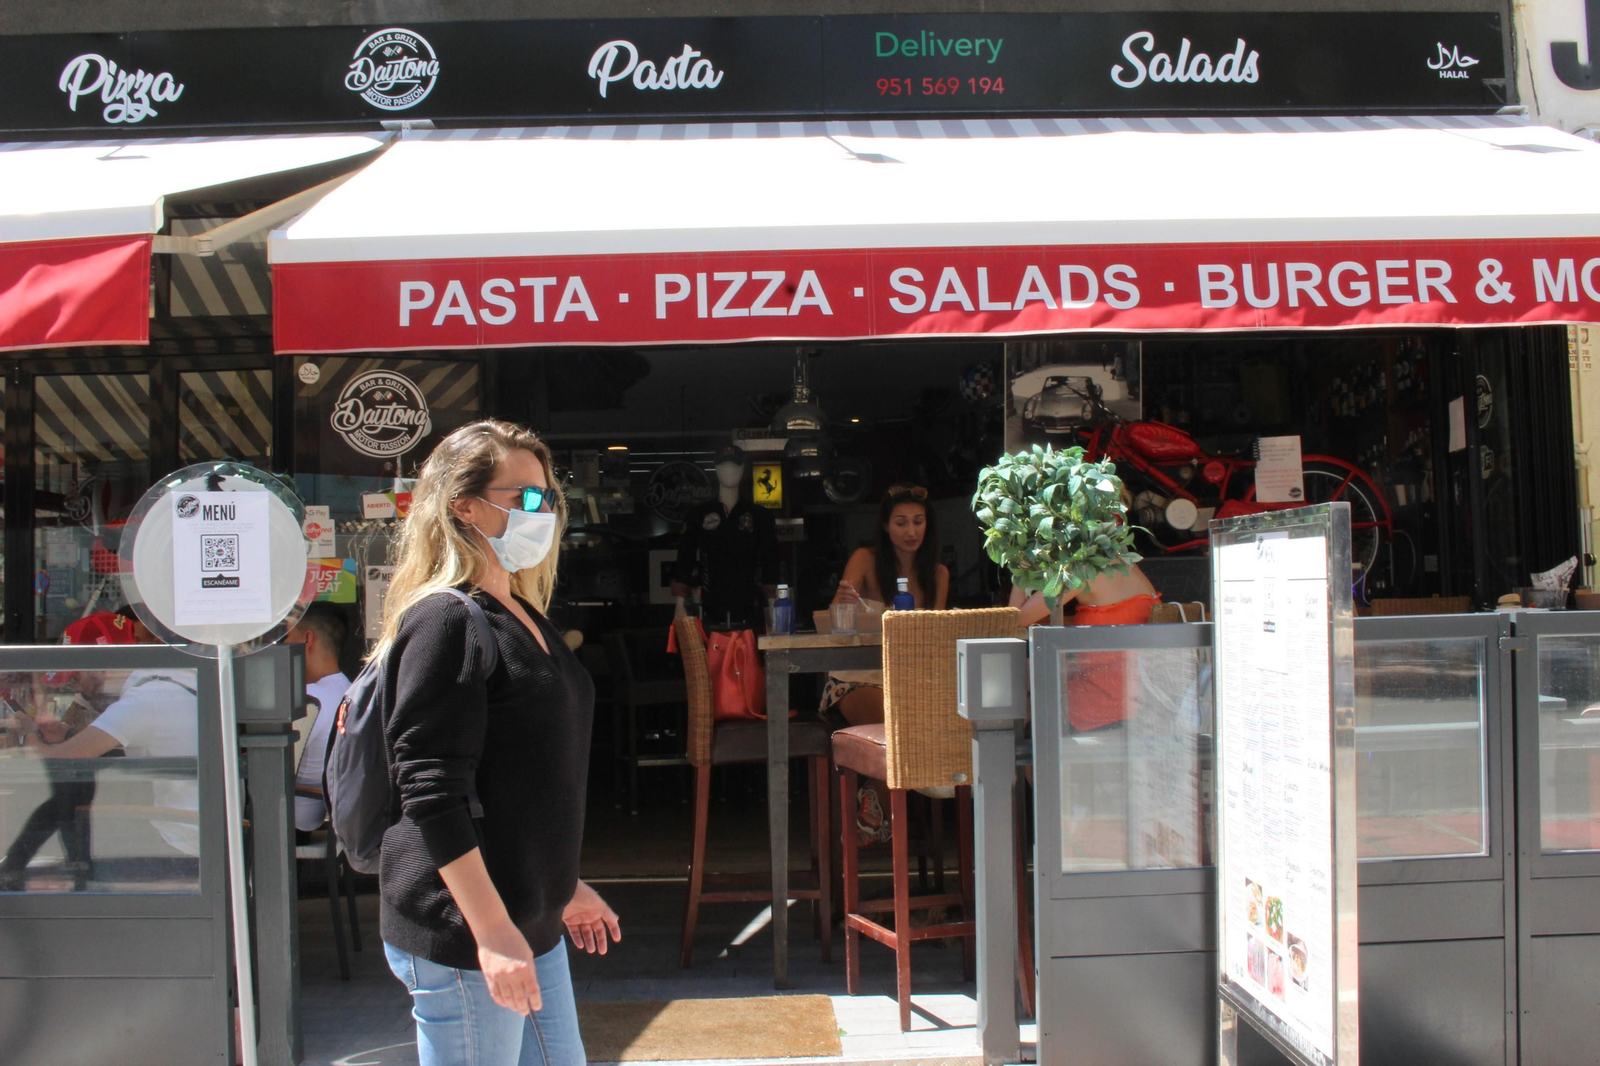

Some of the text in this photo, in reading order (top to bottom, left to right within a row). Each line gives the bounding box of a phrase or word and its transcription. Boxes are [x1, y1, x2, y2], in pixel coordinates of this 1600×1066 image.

[367, 36, 386, 49] BAR
[394, 33, 418, 48] GRILL
[875, 30, 1004, 64] Delivery
[1111, 31, 1260, 89] Salads
[1427, 41, 1480, 70] حلال
[344, 55, 440, 91] Daytona
[588, 39, 724, 98] Pasta
[1439, 70, 1470, 79] HALAL
[59, 53, 185, 124] Pizza
[365, 85, 425, 106] MOTOR PASSION
[875, 76, 1006, 97] 951 569 194
[399, 275, 600, 327] PASTA
[655, 269, 834, 320] PIZZA
[888, 263, 1141, 314] SALADS
[1197, 258, 1458, 309] BURGER
[1474, 258, 1516, 304] &
[359, 379, 377, 391] BAR
[385, 379, 408, 396] GRILL
[333, 398, 428, 434] Daytona
[353, 429, 412, 450] MOTOR PASSION
[202, 501, 236, 521] MENÚ
[203, 578, 238, 587] ESCANÉAME
[309, 569, 342, 583] JUST
[316, 582, 342, 593] EAT
